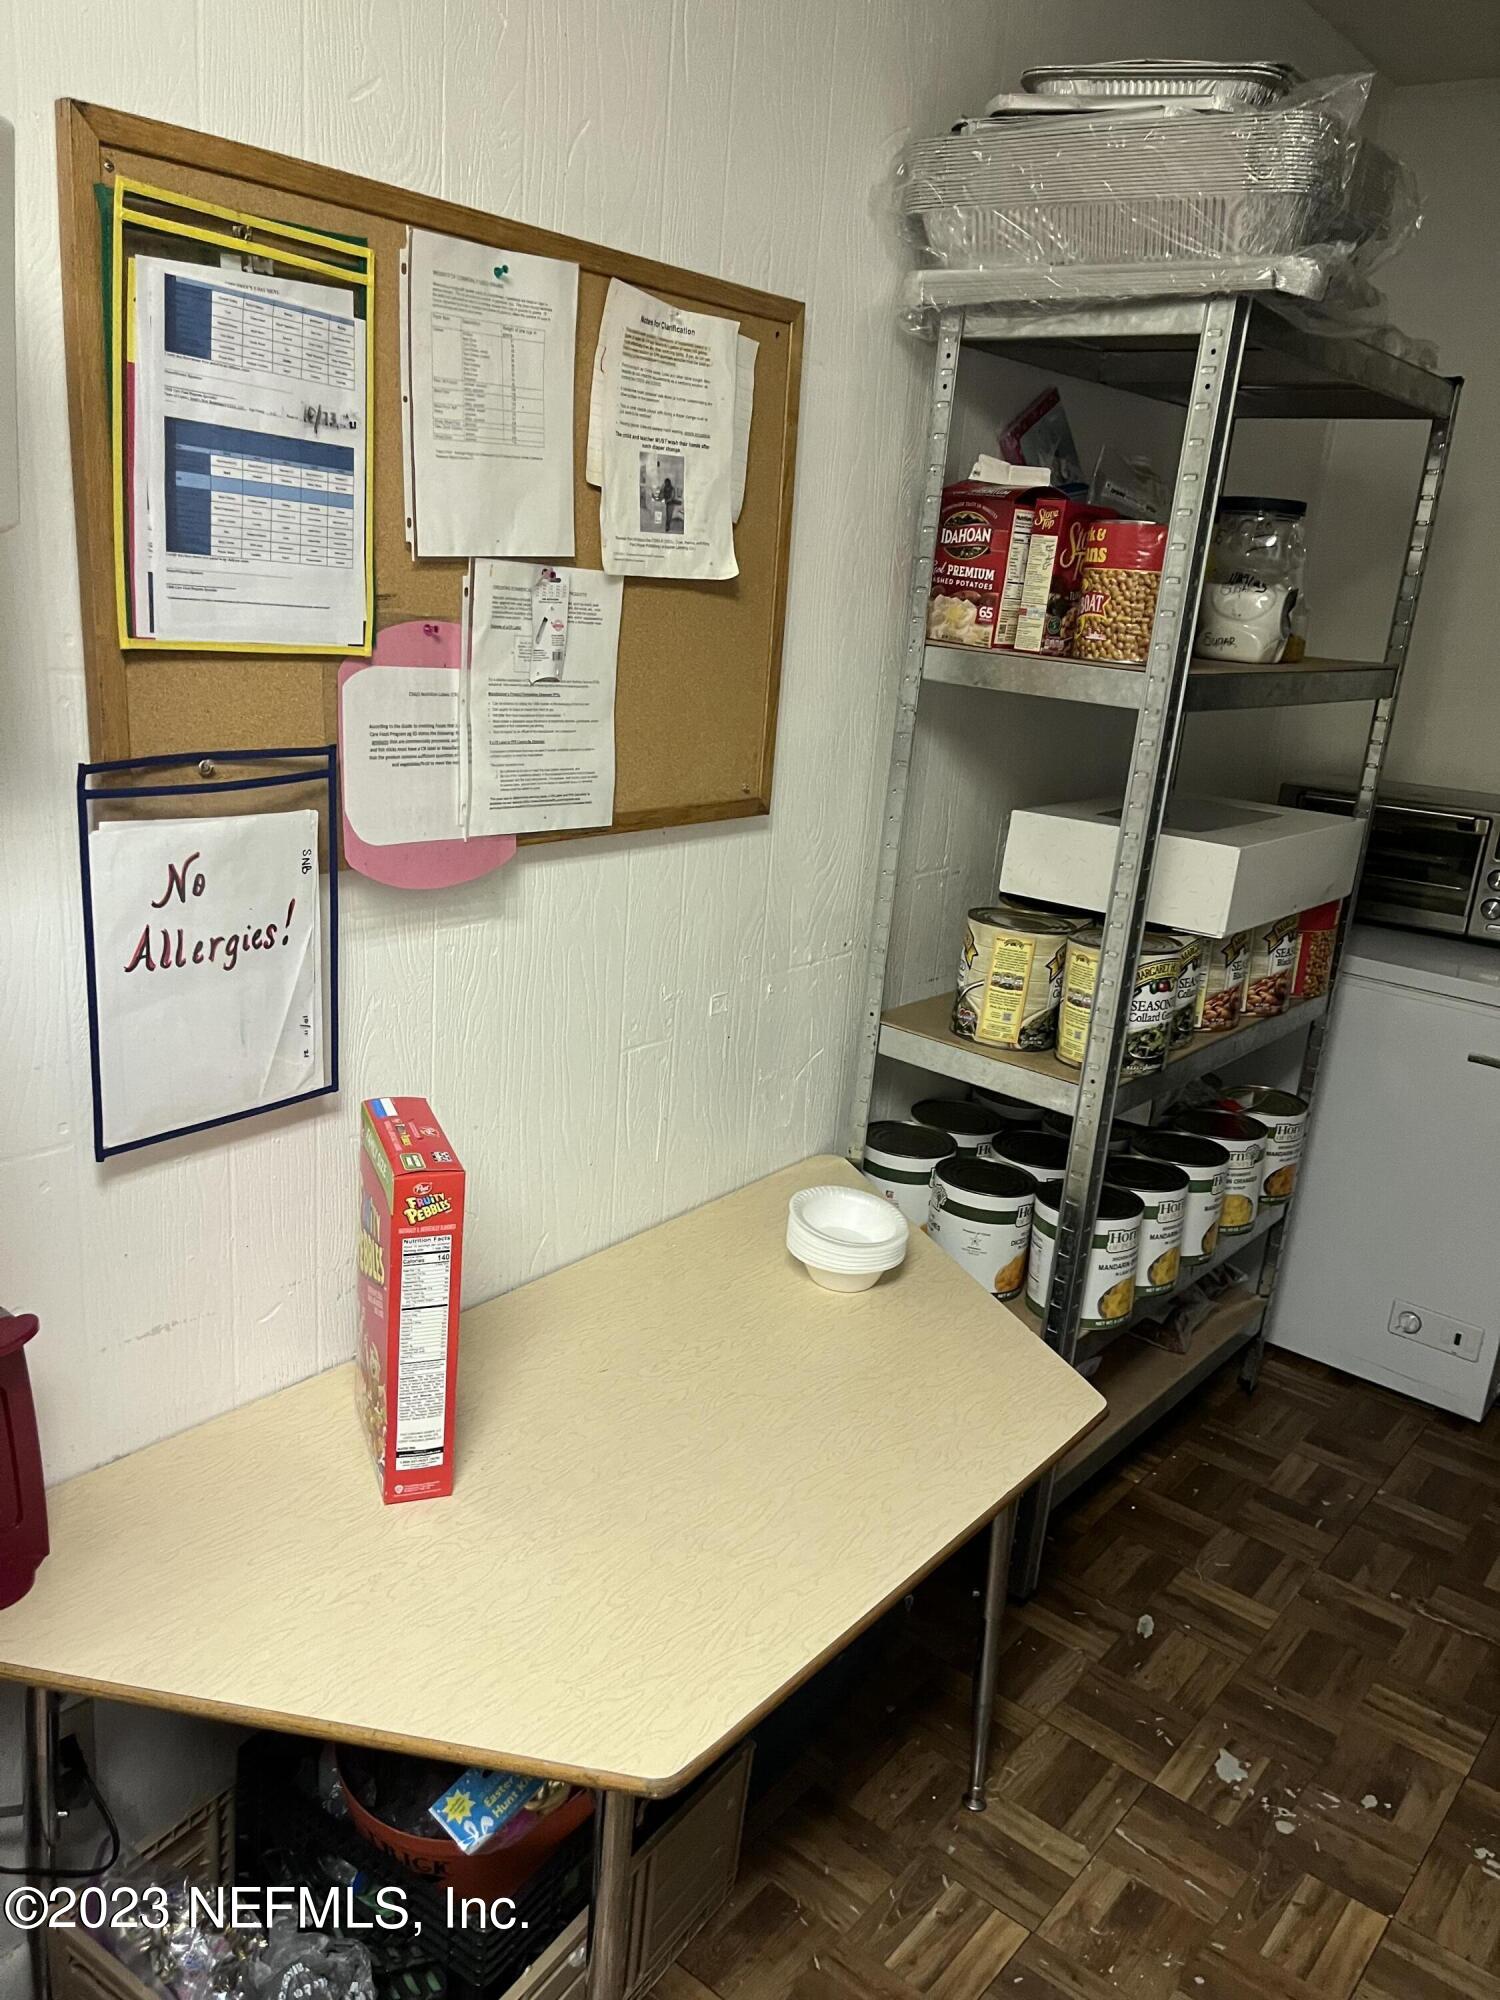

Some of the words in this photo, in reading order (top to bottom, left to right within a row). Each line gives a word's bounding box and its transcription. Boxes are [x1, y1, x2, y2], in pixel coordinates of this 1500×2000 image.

[640, 315, 654, 327] Notes
[660, 321, 696, 336] Clarification
[940, 527, 992, 545] IDAHOAN
[946, 563, 996, 582] PREMIUM
[955, 579, 993, 590] POTATOES
[978, 605, 993, 619] 65
[151, 851, 207, 910] No
[122, 897, 297, 974] Allergies!
[1128, 1012, 1161, 1023] Collard
[405, 1193, 446, 1209] FRUITY
[403, 1199, 452, 1225] PEBBLES
[437, 1253, 450, 1261] 140
[1097, 1262, 1131, 1271] MANDARIN
[482, 1776, 515, 1809] Easter
[491, 1790, 520, 1820] Hunt
